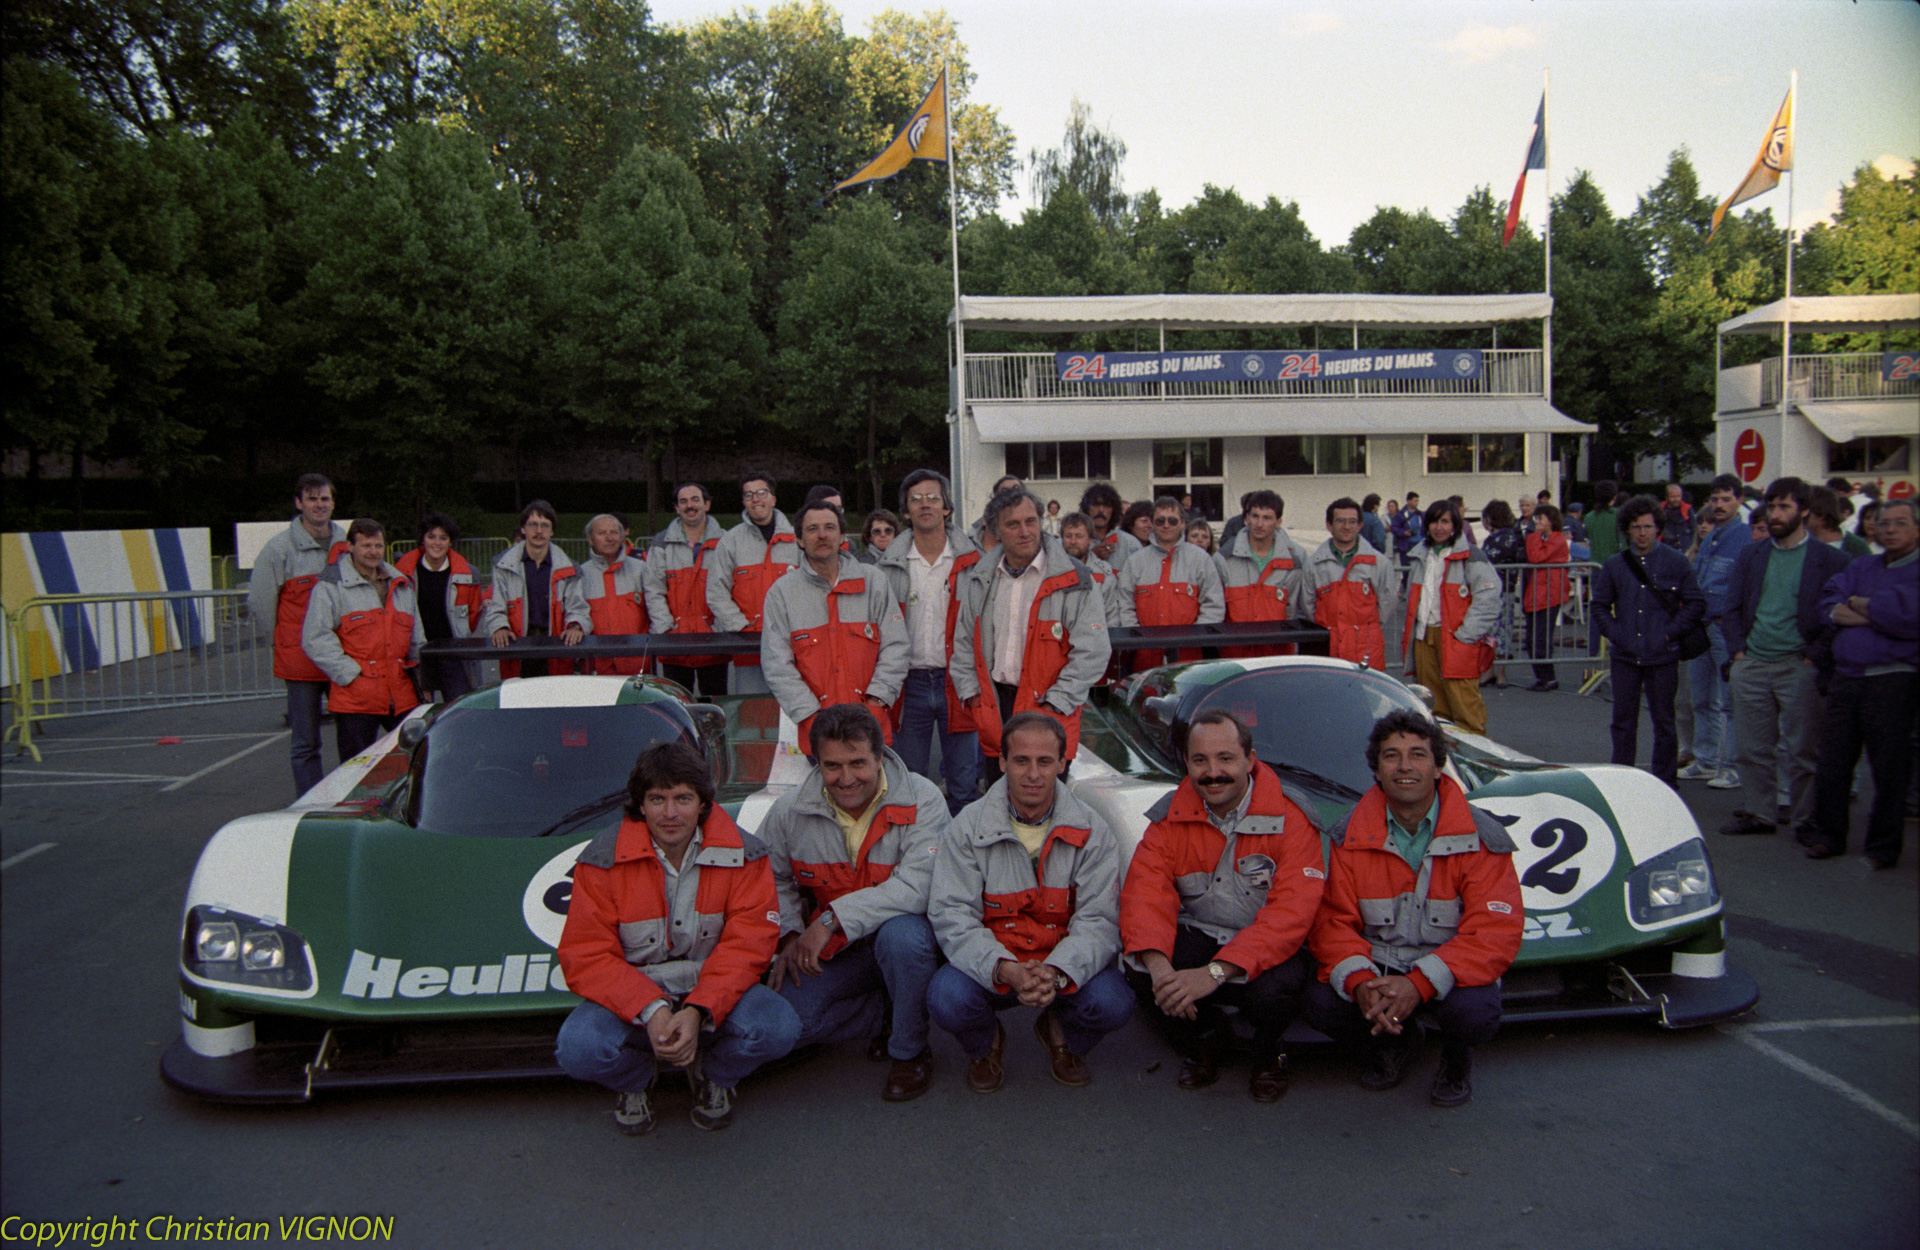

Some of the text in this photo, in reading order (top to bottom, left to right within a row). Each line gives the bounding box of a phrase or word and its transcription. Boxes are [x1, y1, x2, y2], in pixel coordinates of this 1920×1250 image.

[1062, 354, 1107, 381] 24
[1110, 361, 1159, 378] HEURES
[1161, 358, 1180, 374] DU
[1278, 353, 1322, 380] 24
[1324, 358, 1372, 376] HEURES
[1374, 355, 1394, 371] DU
